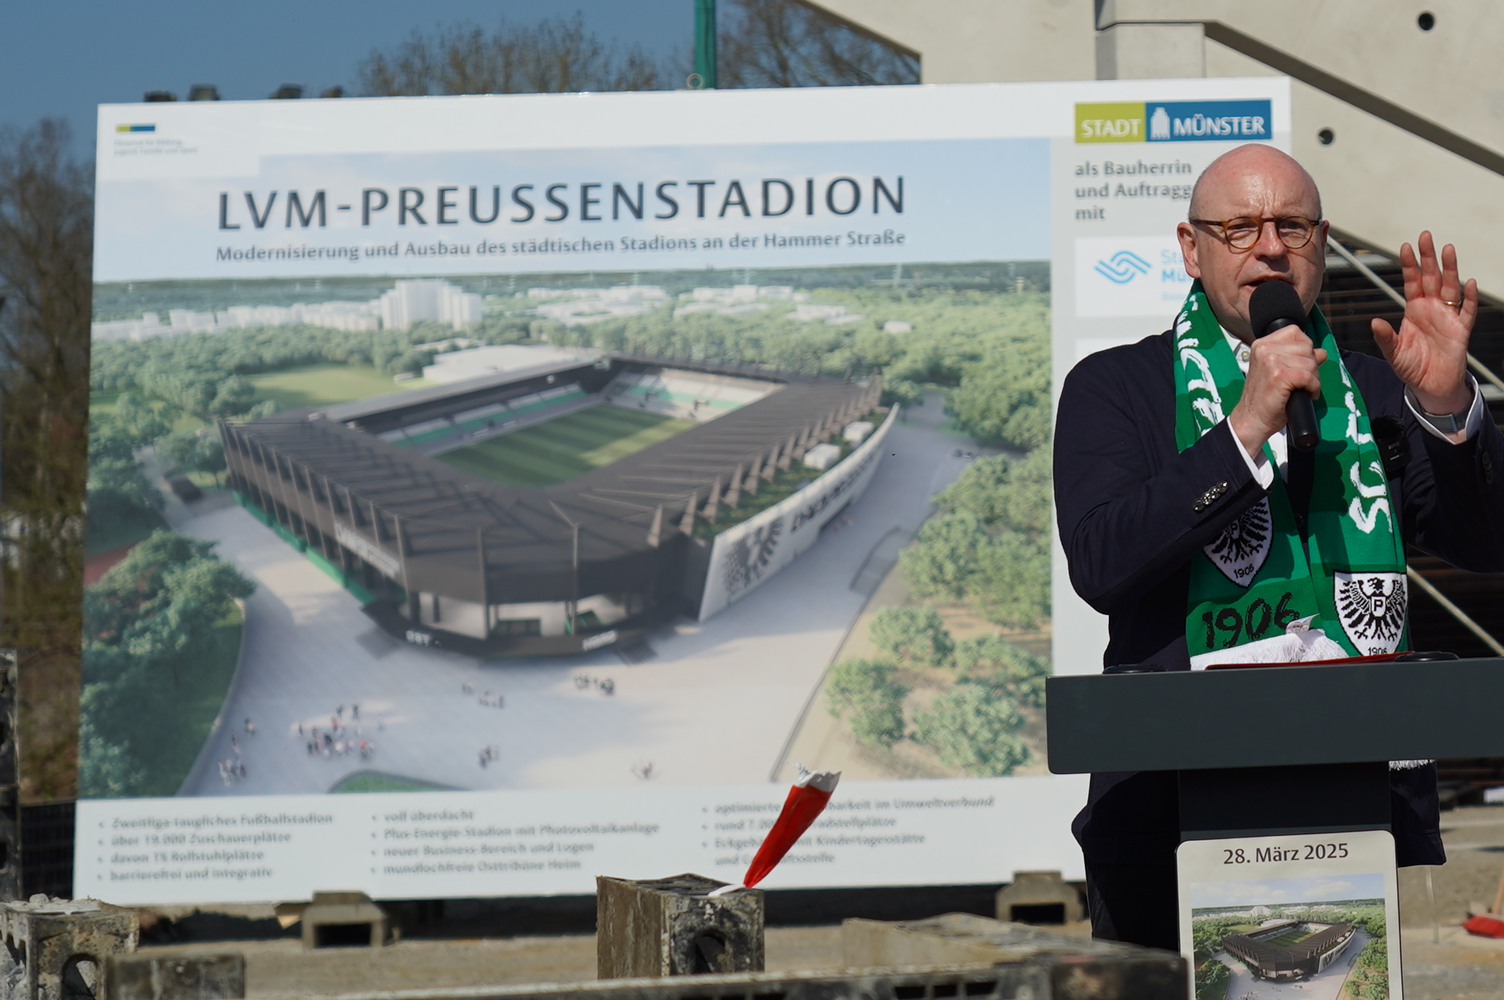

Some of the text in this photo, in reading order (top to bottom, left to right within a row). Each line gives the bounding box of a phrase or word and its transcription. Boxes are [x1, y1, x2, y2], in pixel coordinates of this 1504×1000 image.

[1081, 113, 1266, 138] STADT MÜNSTER
[1075, 159, 1192, 176] als Bauherrin
[1075, 181, 1193, 200] und Auftragg
[218, 175, 904, 230] LVM-PREUSSENSTADION
[1075, 206, 1106, 220] mit
[216, 229, 906, 261] Modernisierung und Ausbau des städtischen Stadions an der Hammer Straße
[1233, 564, 1255, 579] 1906
[1373, 600, 1384, 612] P
[1202, 592, 1300, 649] 1906
[241, 813, 333, 825] Fußballstadion
[515, 825, 535, 836] mit
[530, 842, 554, 853] und
[1223, 843, 1349, 865] 28. März 2025
[185, 867, 208, 879] und
